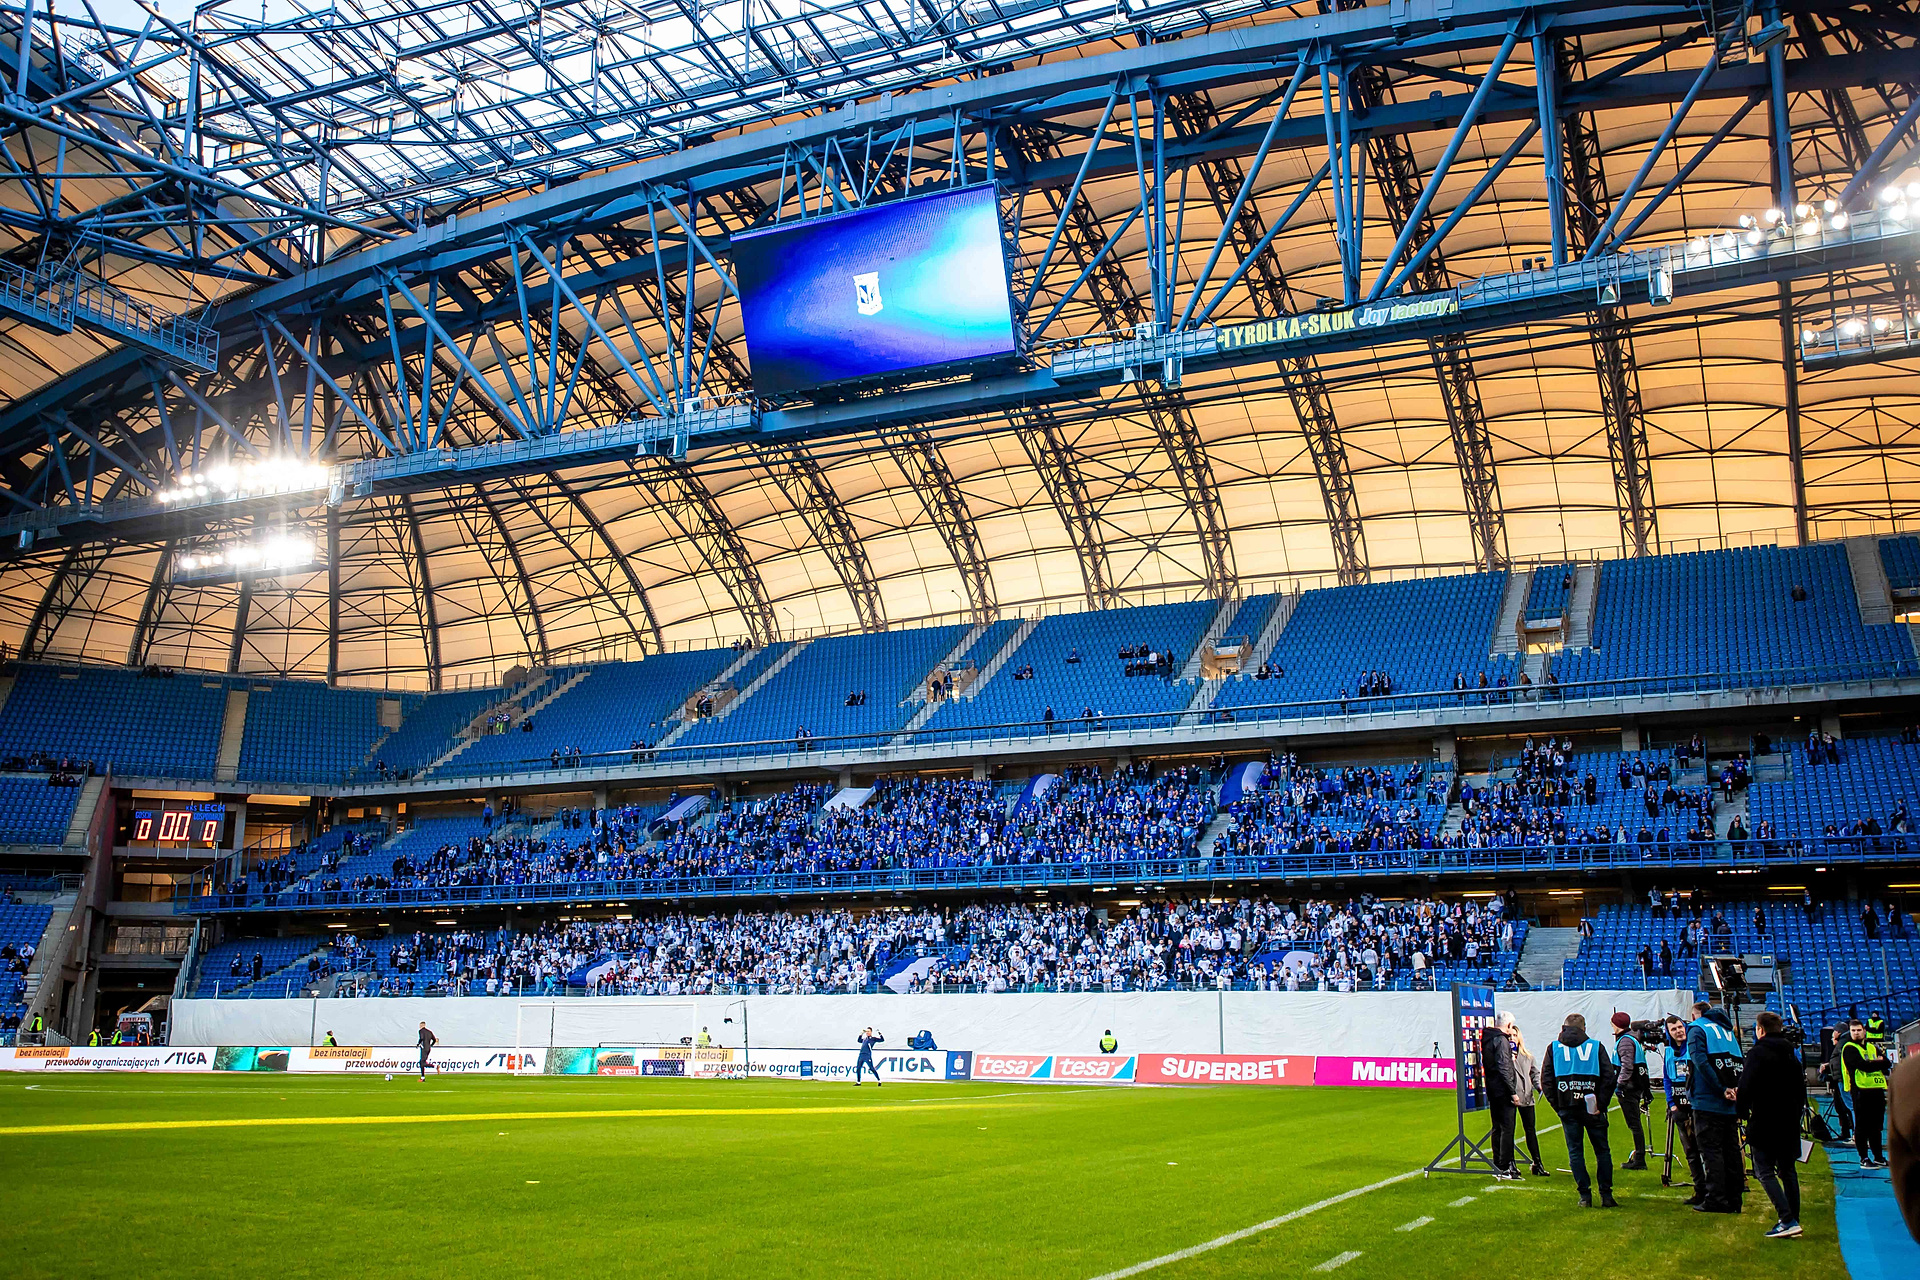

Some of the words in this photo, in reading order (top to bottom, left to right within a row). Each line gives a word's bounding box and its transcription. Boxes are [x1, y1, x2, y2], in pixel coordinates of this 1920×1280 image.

[1359, 307, 1390, 326] Joy
[199, 803, 226, 812] LECH
[137, 819, 152, 840] 0
[202, 821, 217, 841] 0
[1704, 1023, 1733, 1042] TV
[19, 1049, 31, 1057] bez
[32, 1048, 66, 1059] instalacji
[45, 1057, 91, 1069] przewodów
[92, 1057, 160, 1070] ograniczających
[164, 1052, 207, 1065] STIGA
[314, 1049, 328, 1057] bez
[329, 1048, 368, 1060] instalacji
[664, 1050, 680, 1060] bez
[1557, 1043, 1593, 1062] TV
[345, 1058, 399, 1070] przewodów
[979, 1057, 1028, 1074] tesa
[1060, 1058, 1110, 1076] tesa
[1161, 1057, 1289, 1081] SUPERBET
[1352, 1061, 1457, 1083] Multikin
